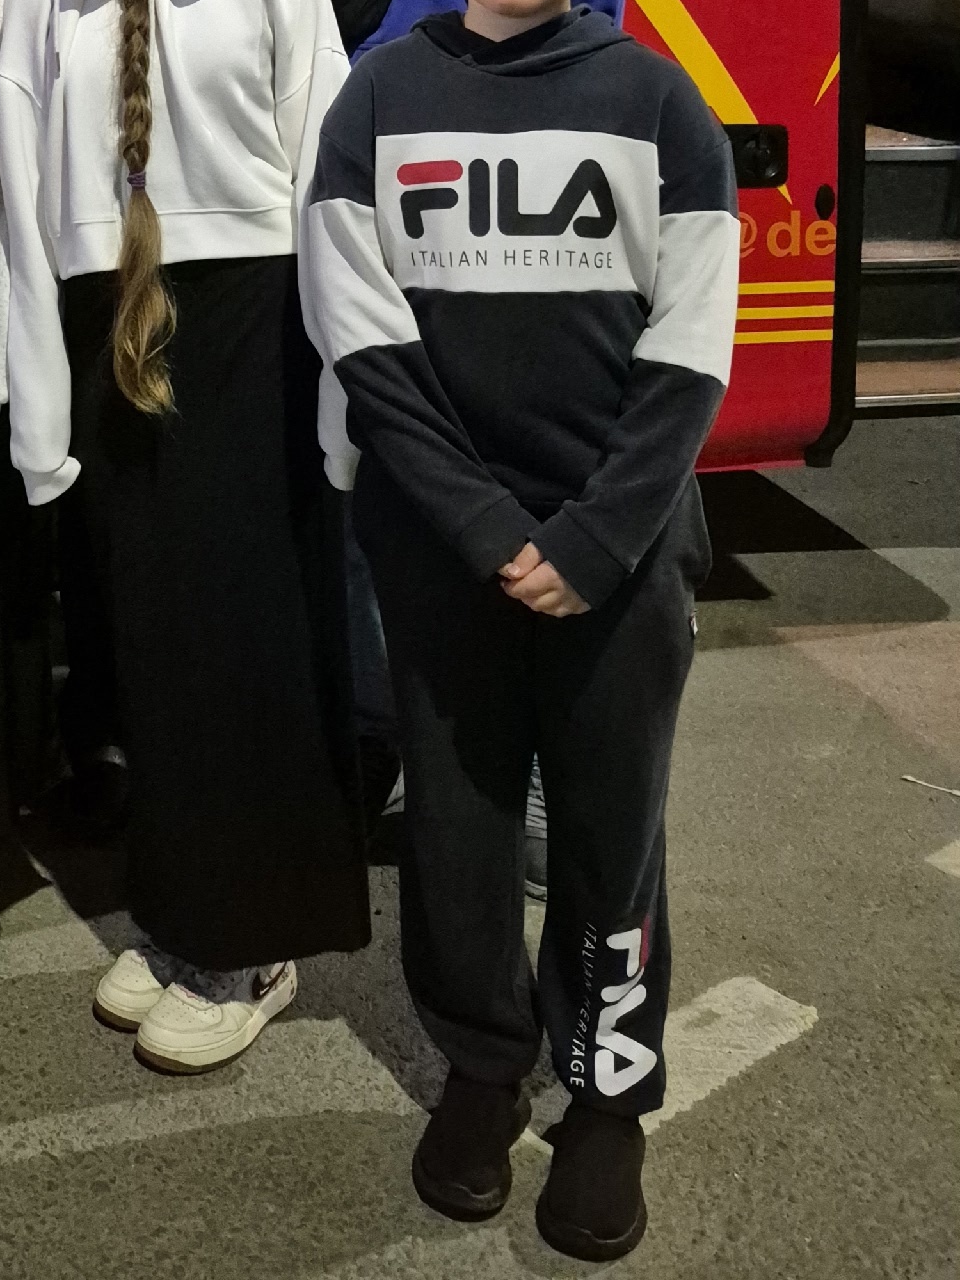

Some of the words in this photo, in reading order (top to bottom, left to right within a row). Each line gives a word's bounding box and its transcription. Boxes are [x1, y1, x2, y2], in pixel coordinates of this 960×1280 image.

[396, 158, 618, 240] FILA
[410, 249, 488, 268] ITALIAN
[503, 249, 614, 269] HERITAGE
